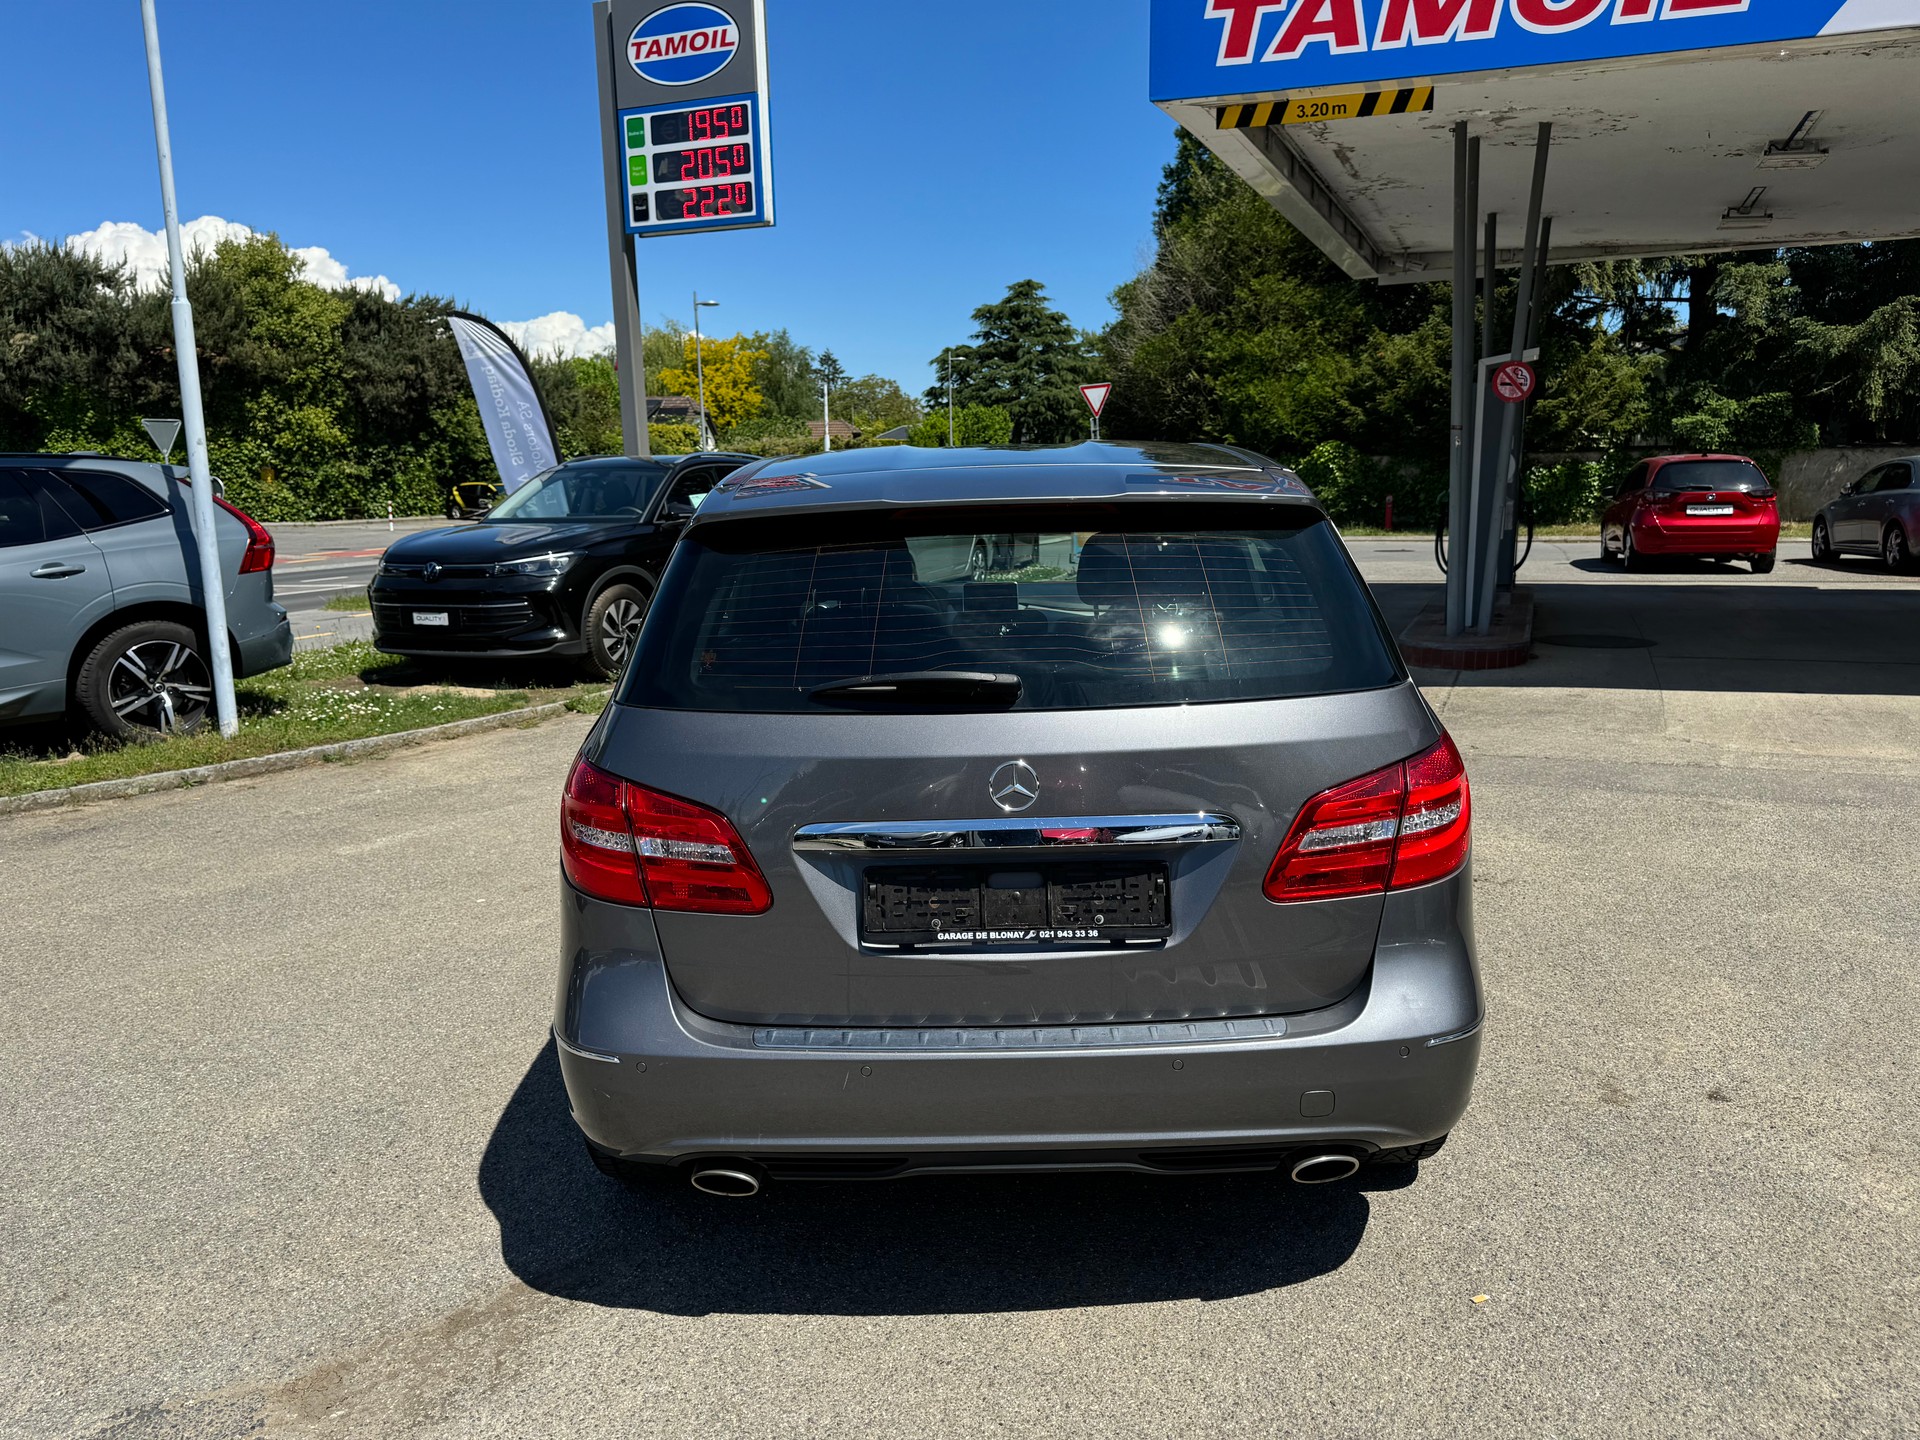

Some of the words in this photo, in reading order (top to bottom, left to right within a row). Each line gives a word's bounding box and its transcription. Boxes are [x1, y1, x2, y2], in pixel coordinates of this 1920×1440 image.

[631, 28, 736, 60] TAMOIL
[1204, 0, 1749, 66] TAM
[1296, 102, 1329, 118] 3.20
[1332, 103, 1347, 115] m
[937, 932, 974, 940] GARAGE
[975, 931, 988, 939] DE
[990, 931, 1024, 939] BLONAY
[1039, 930, 1054, 938] 021
[1057, 930, 1073, 938] 943
[1087, 929, 1099, 937] 36
